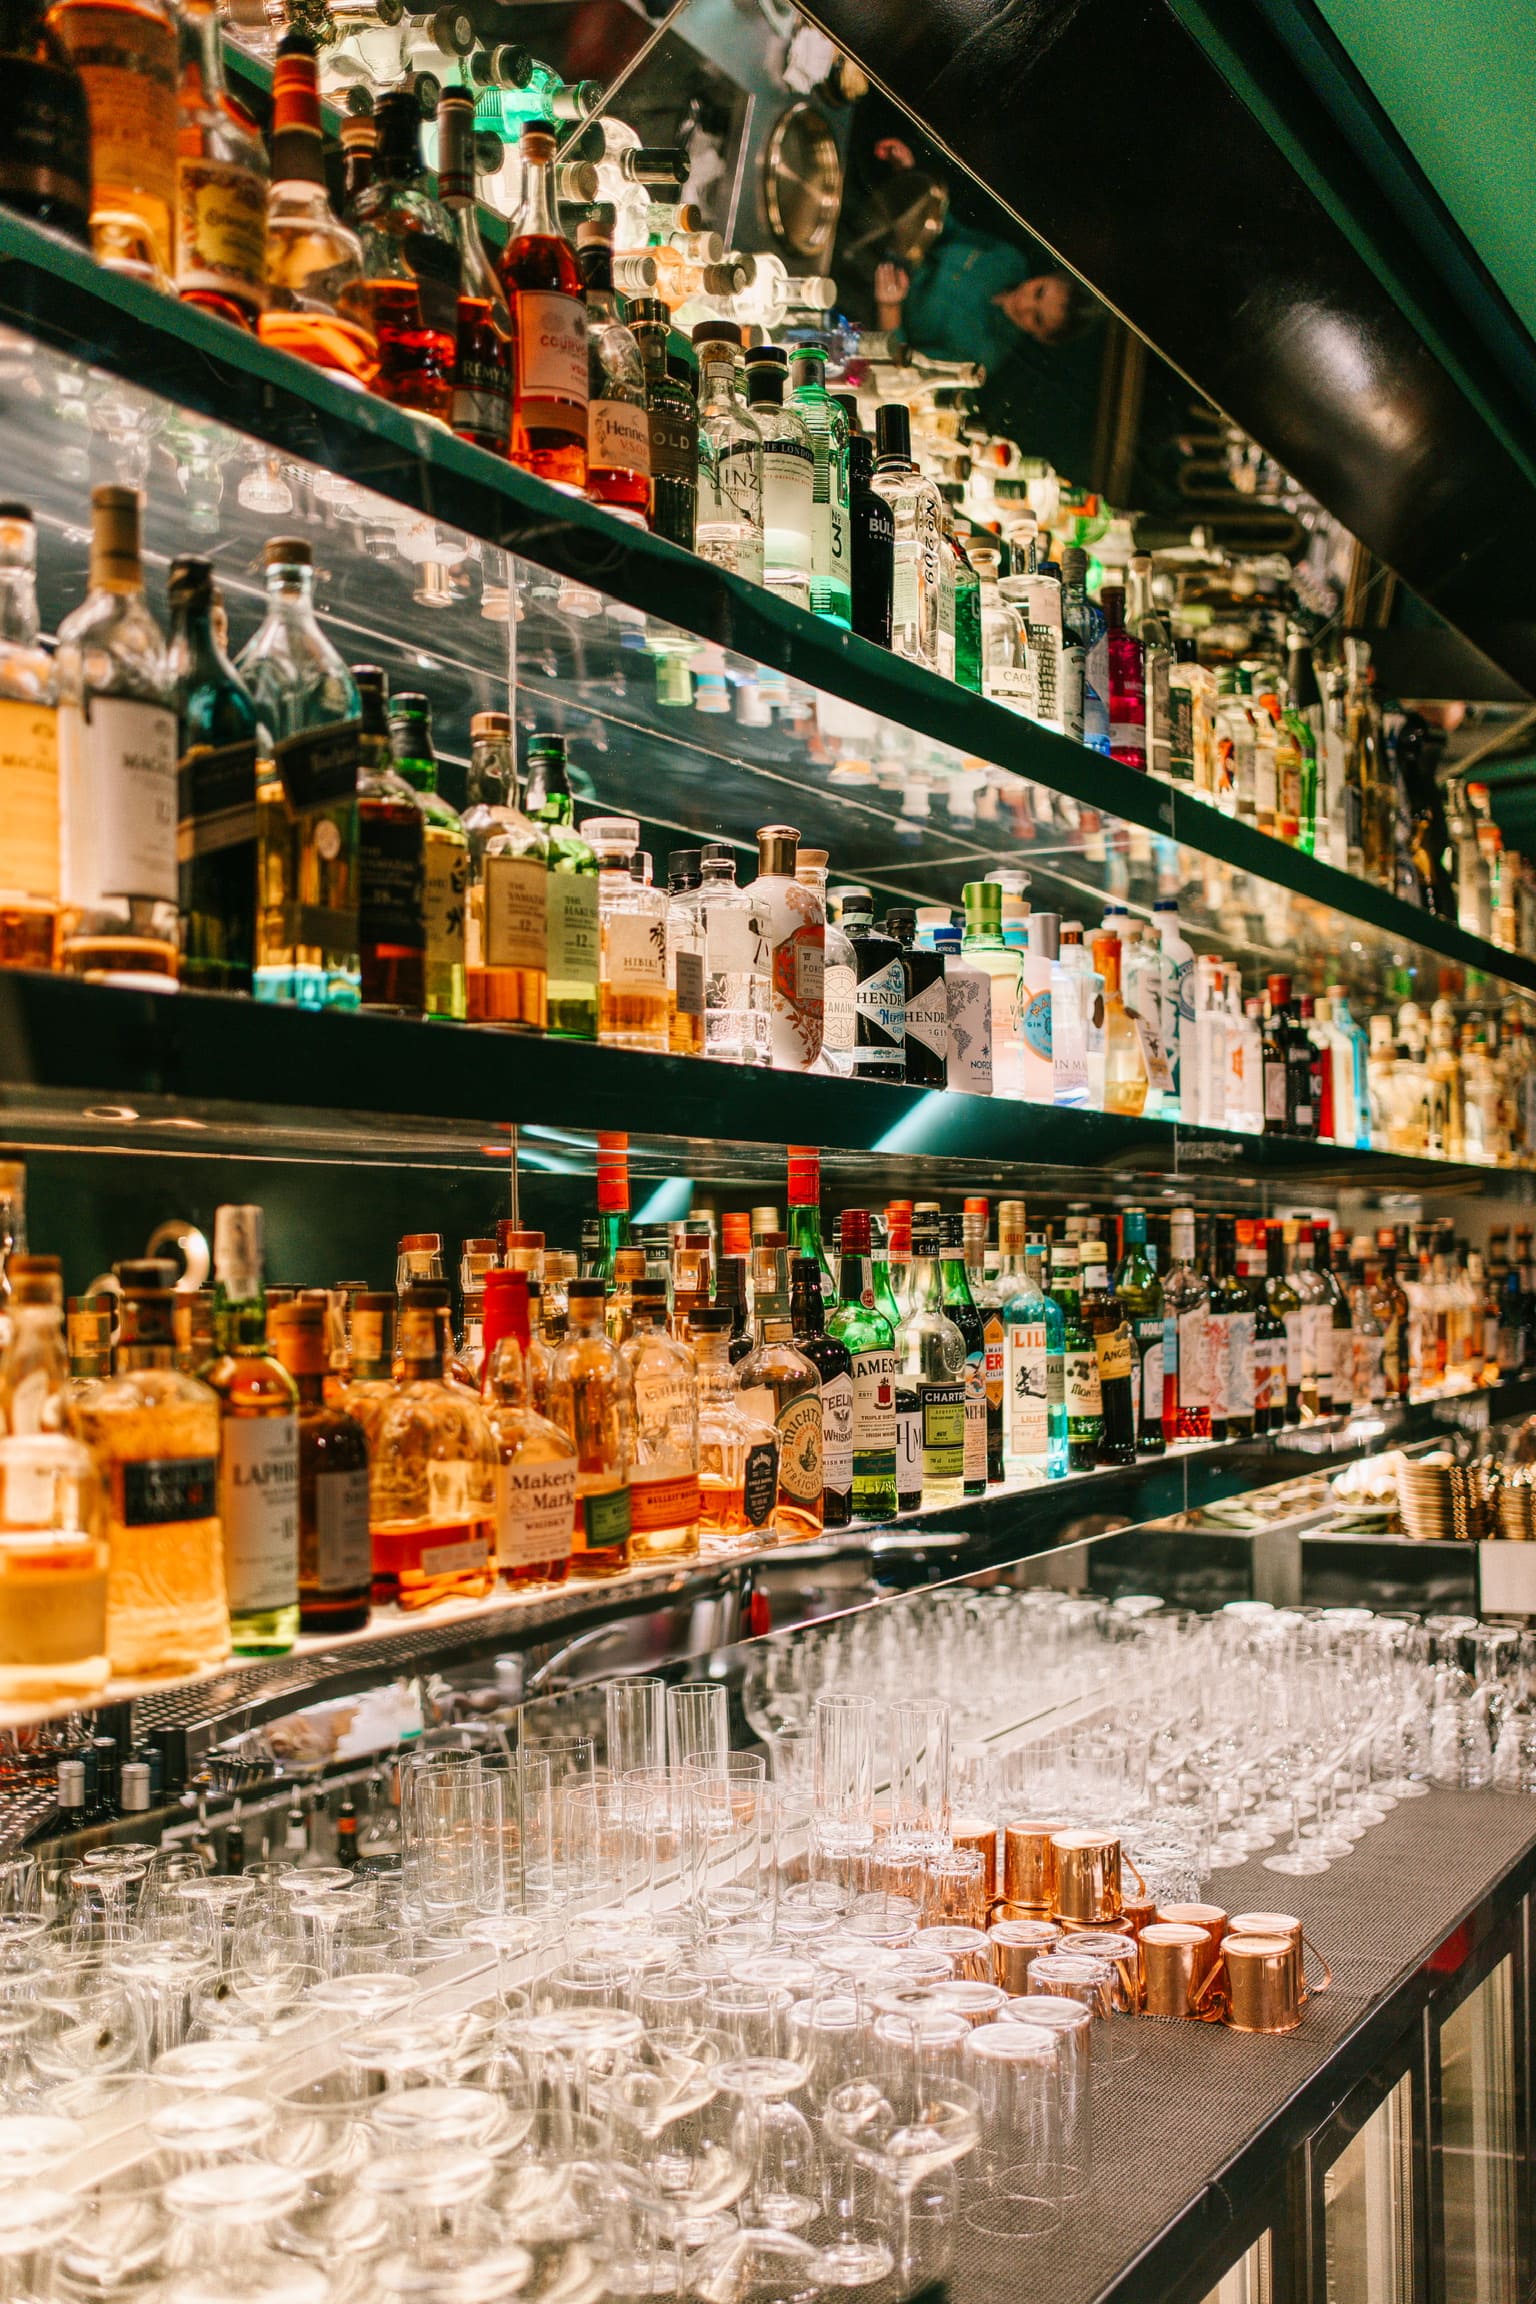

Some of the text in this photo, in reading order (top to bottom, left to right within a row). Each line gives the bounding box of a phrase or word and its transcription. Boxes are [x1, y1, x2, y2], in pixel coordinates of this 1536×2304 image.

[652, 432, 690, 450] OLD
[831, 522, 842, 559] 3
[576, 933, 588, 949] 12
[1027, 1021, 1042, 1029] GIN
[510, 1470, 576, 1491] Maker's
[532, 1491, 575, 1511] Mark
